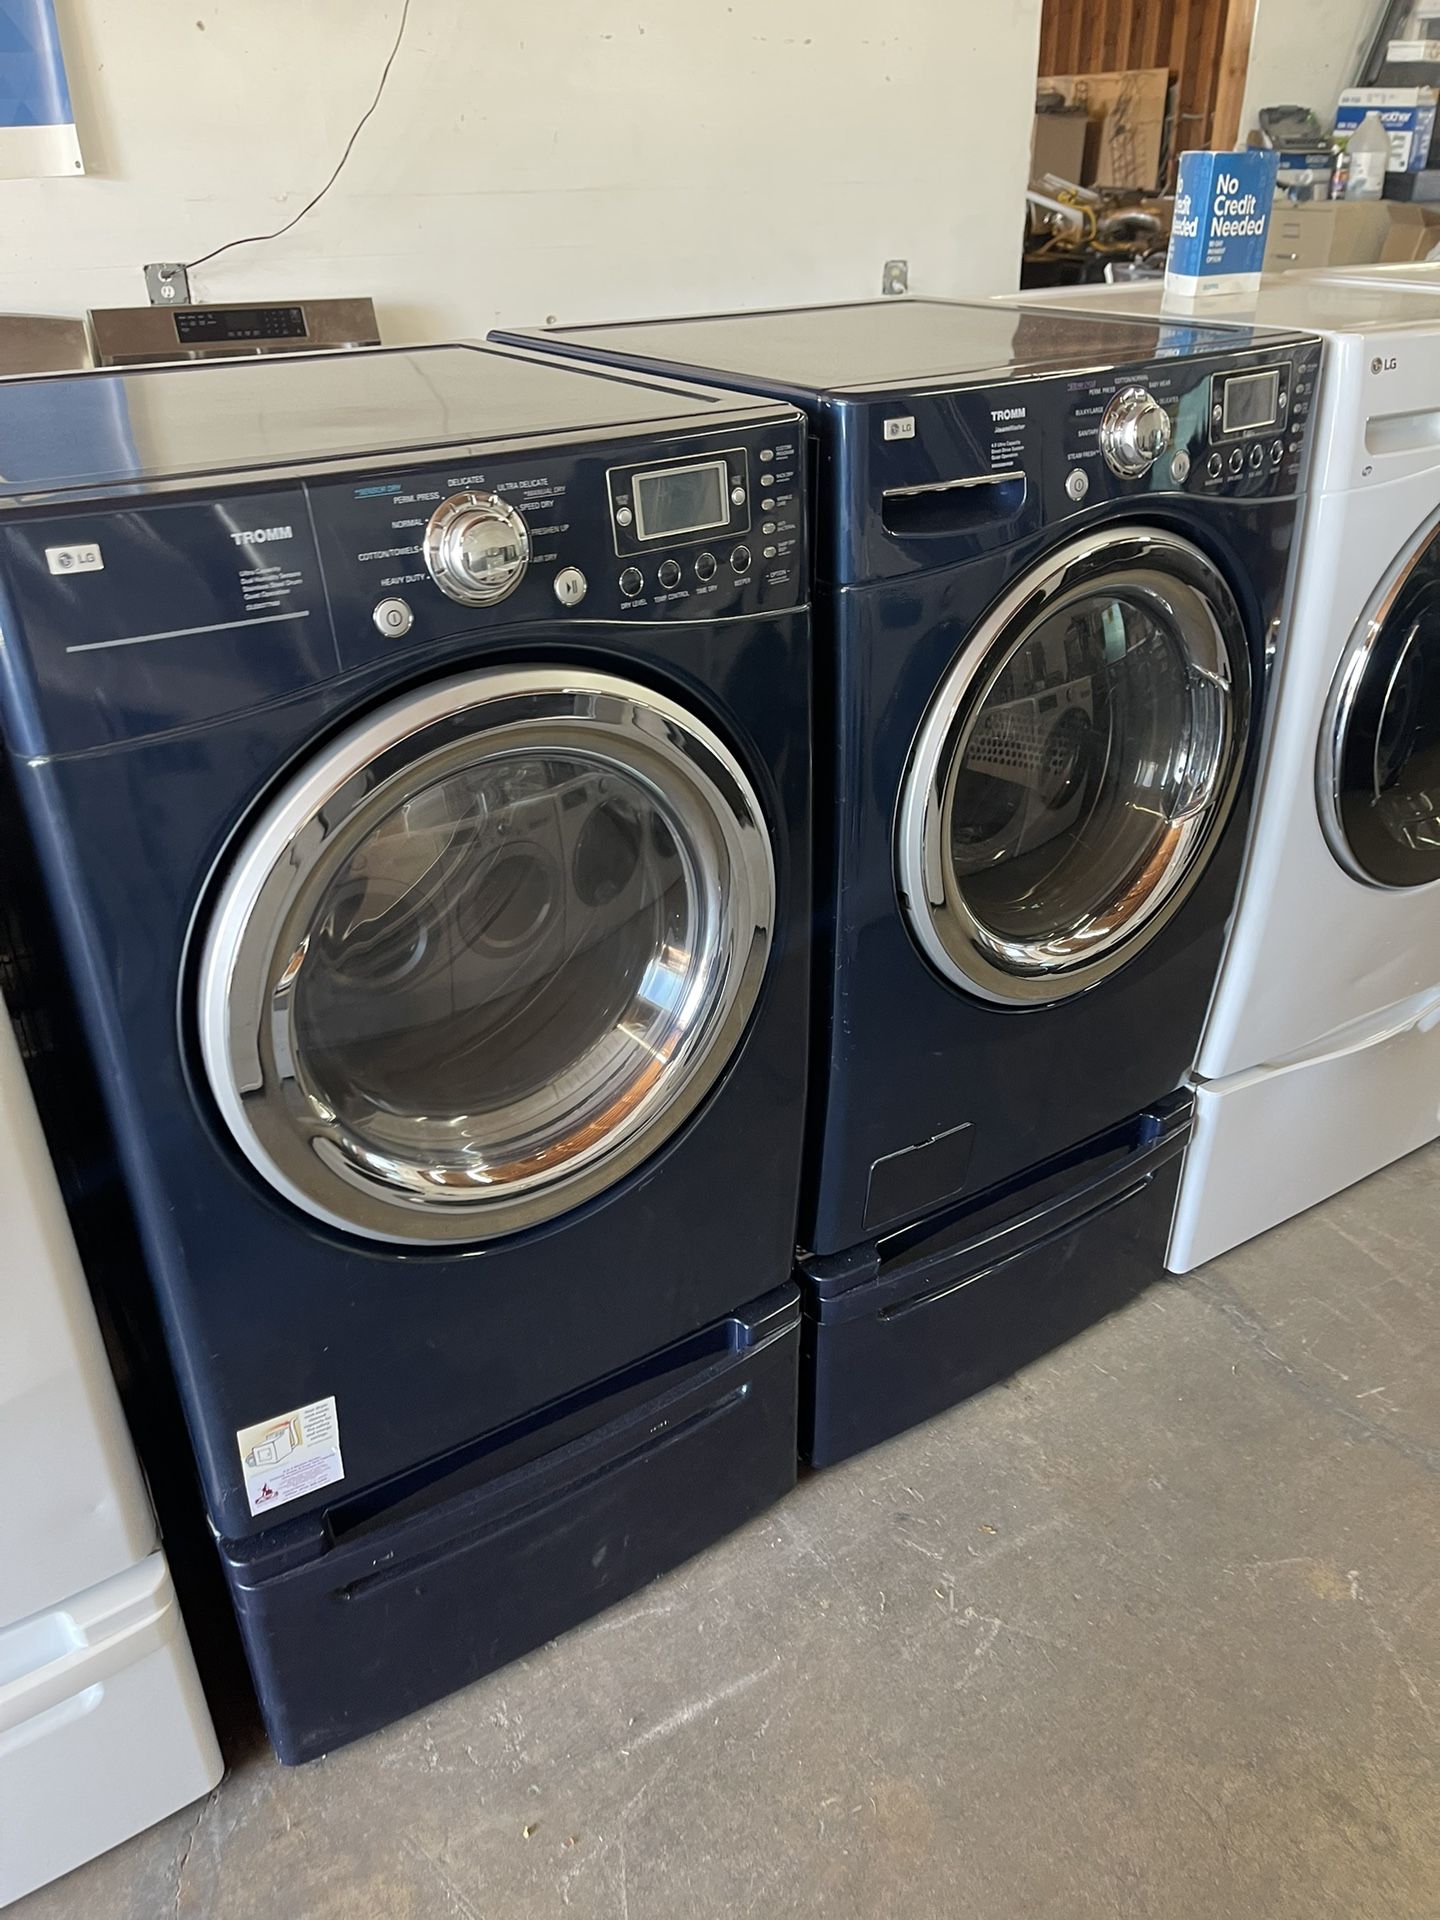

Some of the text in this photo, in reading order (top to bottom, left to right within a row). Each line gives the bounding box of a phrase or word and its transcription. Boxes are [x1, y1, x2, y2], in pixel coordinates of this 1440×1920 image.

[1216, 173, 1239, 195] No
[1213, 194, 1257, 216] Credit
[1211, 214, 1266, 238] Needed
[1384, 358, 1397, 371] LG
[991, 407, 1026, 421] TROMM
[901, 423, 912, 433] LG
[447, 475, 485, 487] DELICATES
[497, 478, 549, 492] ULTRA DELICATE
[416, 491, 440, 501] PRESS
[520, 500, 555, 512] SPEED DRY
[391, 518, 425, 529] NORMAL
[230, 526, 293, 545] TROMM
[78, 552, 95, 564] LG
[358, 545, 420, 561] COTTON/TOWELS
[381, 573, 426, 586] HEAVY DUTY
[620, 602, 632, 610] DRY
